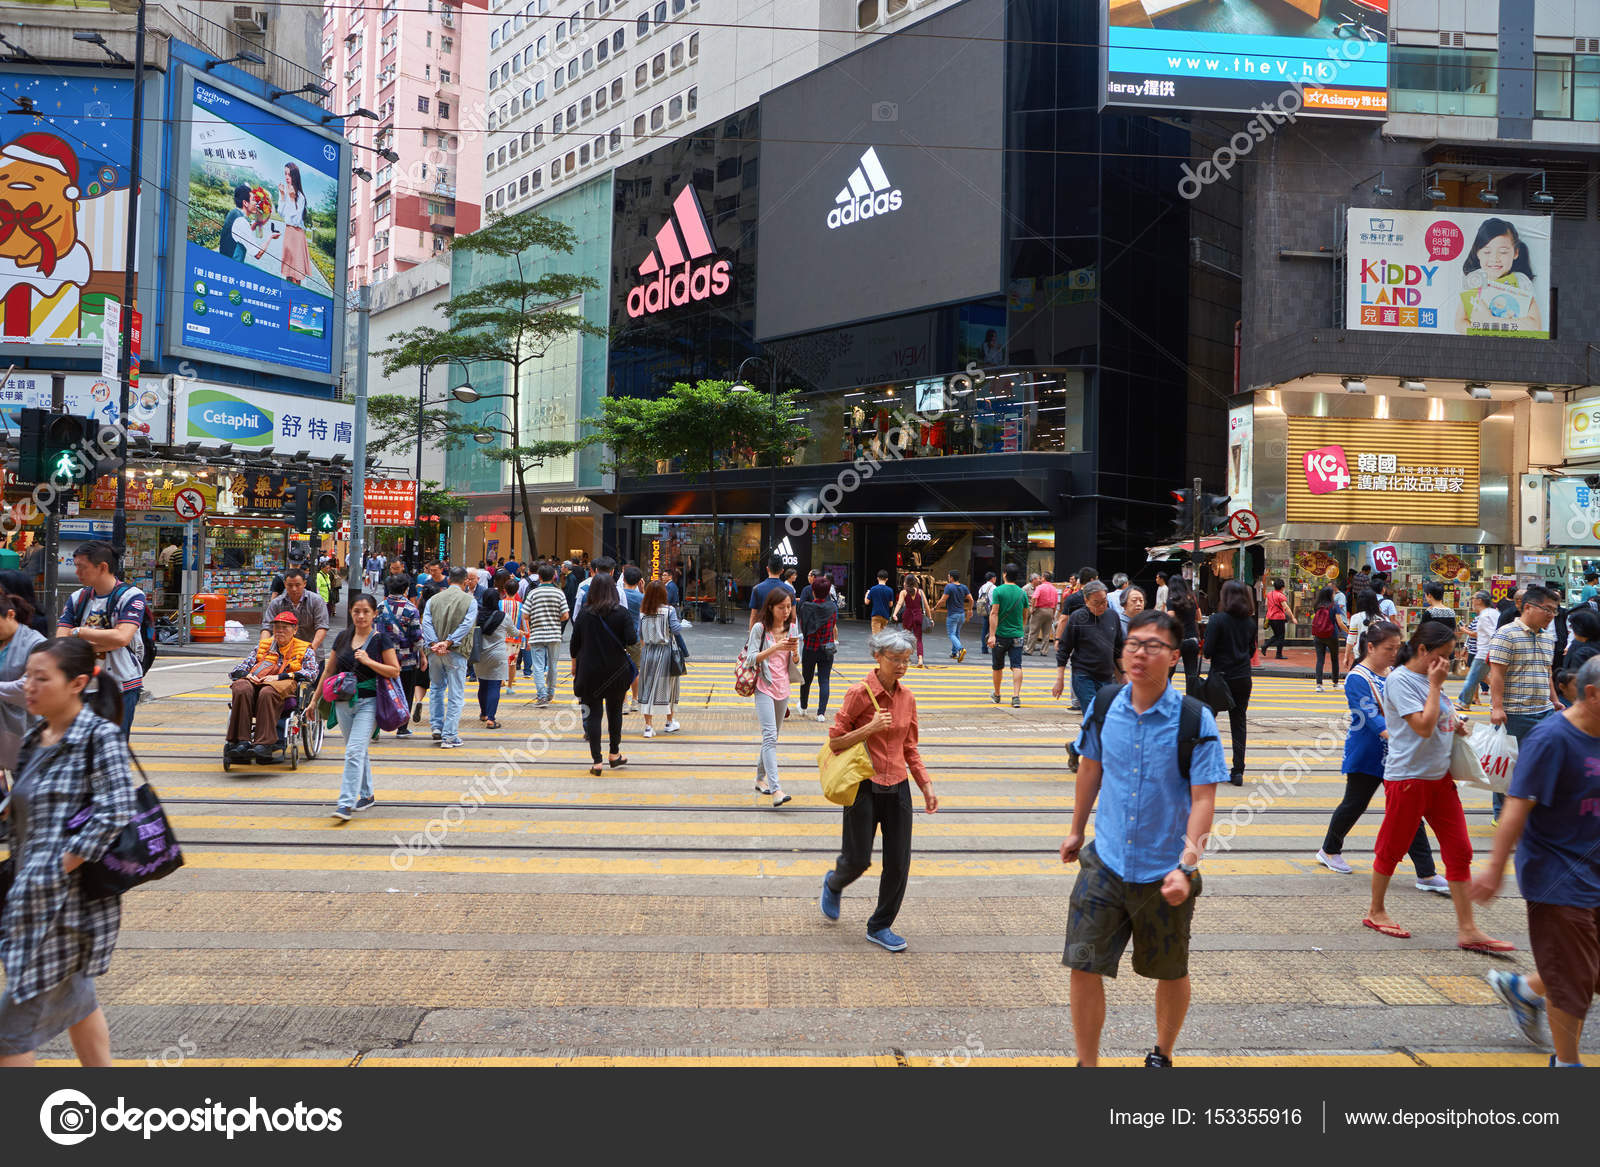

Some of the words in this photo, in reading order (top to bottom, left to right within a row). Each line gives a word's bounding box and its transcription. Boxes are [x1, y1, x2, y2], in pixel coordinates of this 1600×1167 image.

[1168, 57, 1327, 77] www.theV.hk
[1321, 94, 1360, 108] Asiaray
[827, 189, 902, 230] adidas
[627, 260, 730, 318] adidas
[1361, 284, 1422, 307] LAND
[1364, 308, 1434, 325] 兒童天地
[203, 409, 259, 430] Cetaphil
[282, 414, 352, 444] 舒特膚
[1308, 454, 1351, 490] KC+
[1358, 453, 1397, 474] 韓國
[1358, 475, 1465, 493] 護膚化妝品專家
[906, 532, 931, 541] adidas
[1545, 568, 1556, 578] LG
